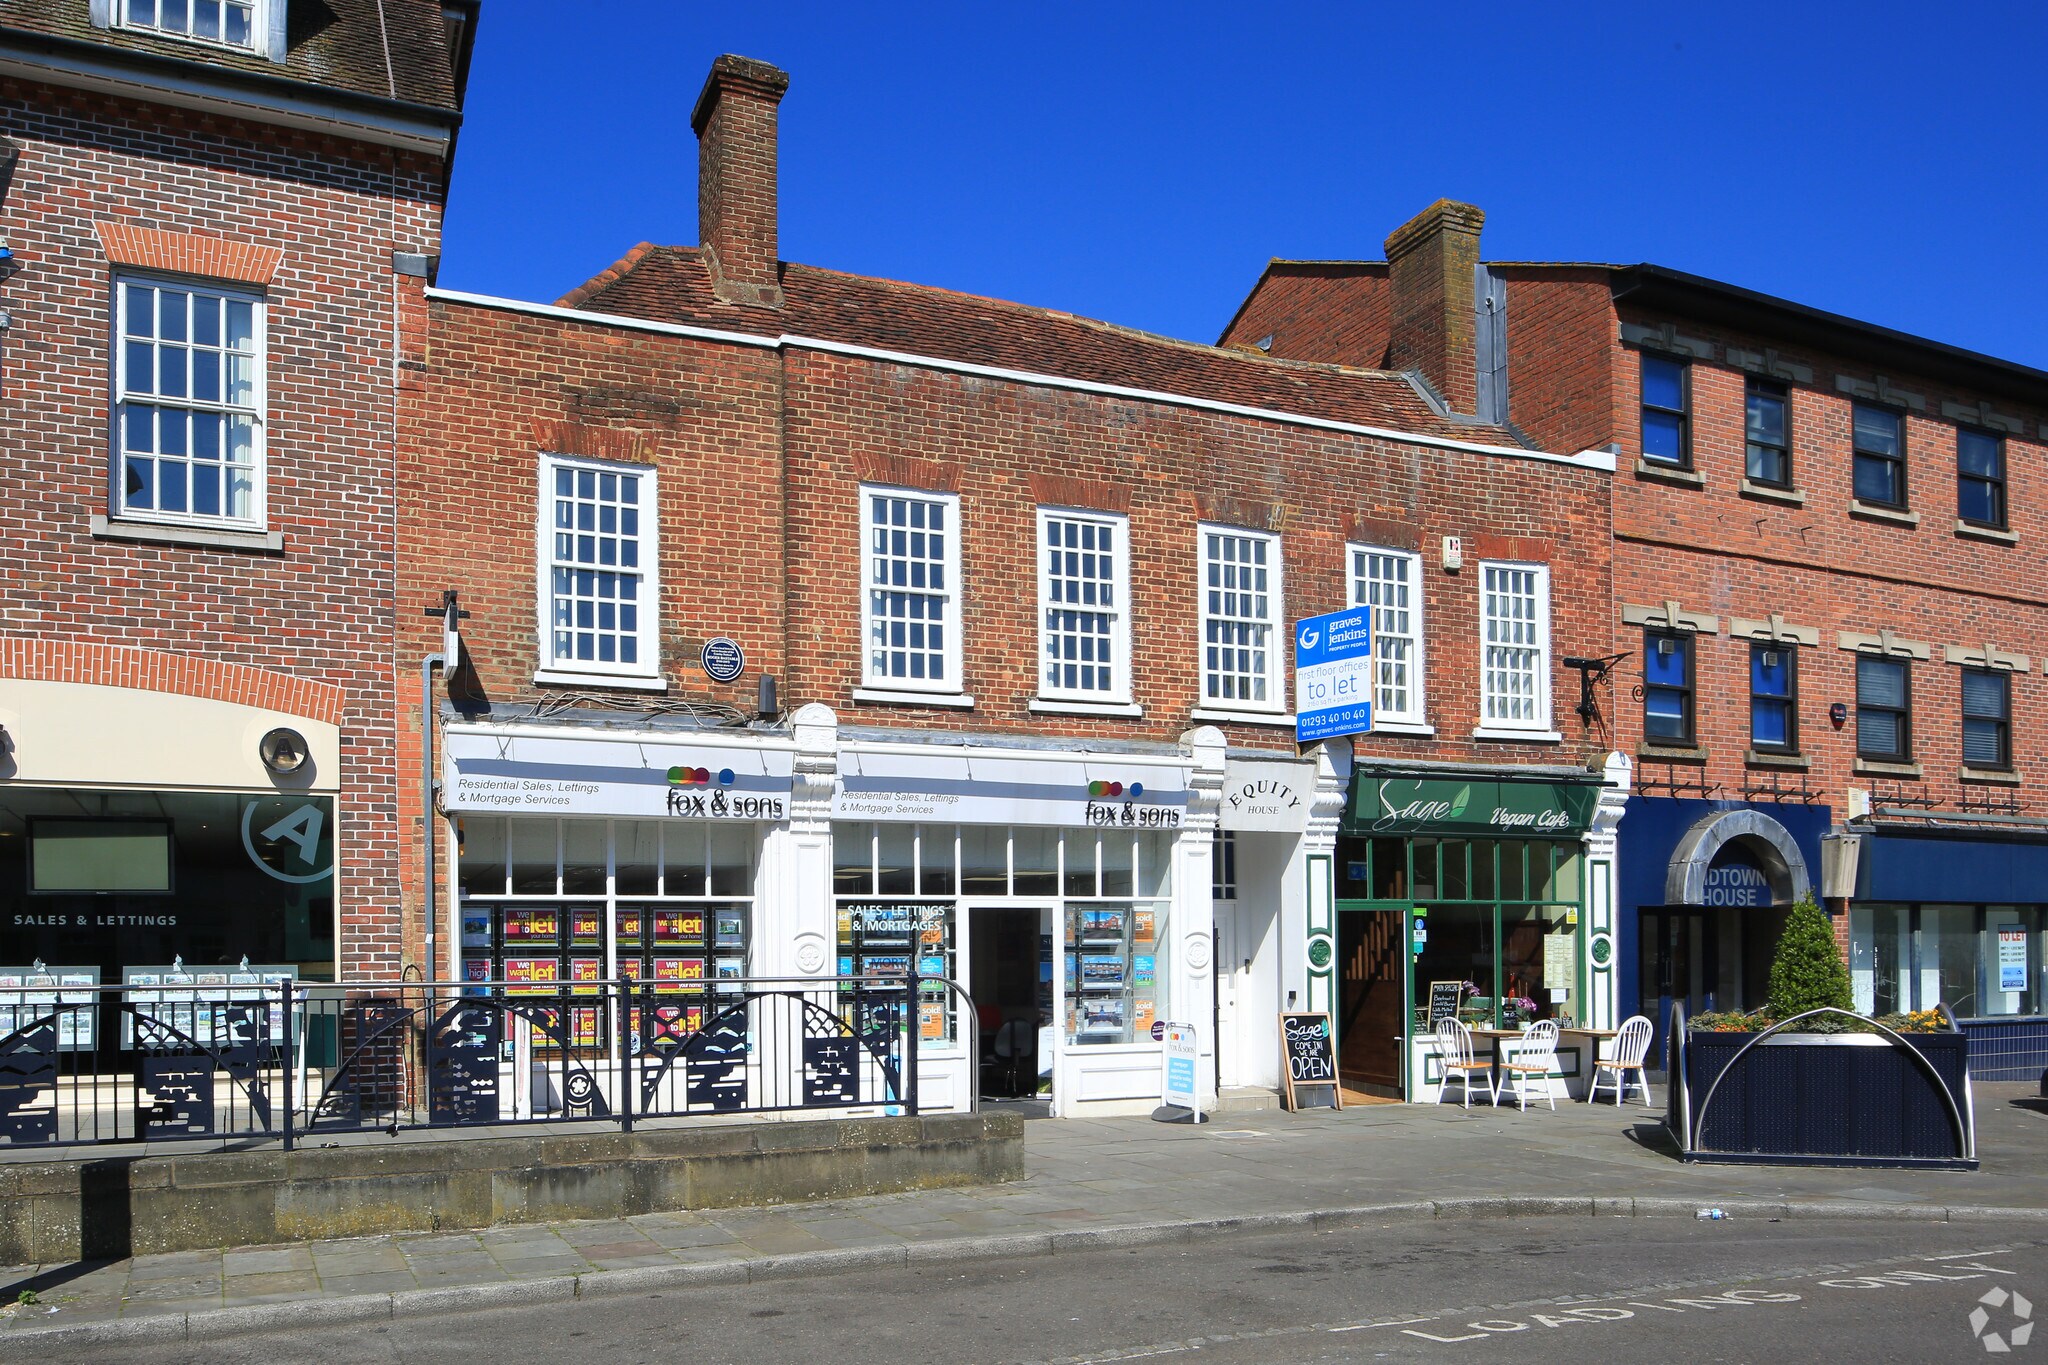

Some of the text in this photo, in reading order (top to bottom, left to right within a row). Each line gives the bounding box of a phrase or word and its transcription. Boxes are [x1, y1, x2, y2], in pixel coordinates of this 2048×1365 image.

[1329, 616, 1361, 632] graves
[1328, 629, 1366, 646] jenkins
[1329, 644, 1350, 652] PROPERTY
[1298, 660, 1368, 680] first floor offices
[1308, 674, 1357, 700] to let
[1302, 709, 1364, 727] 01293 40 10 40
[1302, 722, 1365, 737] www.gravesenkins.com
[458, 779, 599, 794] Residential Sales, Lettings
[1229, 780, 1301, 808] EQUITY
[458, 793, 570, 805] & Mortgage Services
[666, 788, 782, 813] fox & sons
[841, 791, 959, 804] Residential Sales, Lettings
[1372, 773, 1450, 832] Sage
[840, 803, 934, 814] & Mortgage Services
[1085, 800, 1179, 822] fox & sons
[1248, 806, 1279, 814] HOUSE
[1490, 808, 1536, 831] Vegan
[260, 803, 324, 866] A
[1705, 869, 1766, 886] DTOWN
[1703, 888, 1756, 906] HOUSE
[847, 905, 945, 916] SALES, LETTINGS
[14, 915, 177, 925] SALES & LETTINGS
[530, 912, 555, 933] let
[581, 919, 596, 932] let
[623, 919, 638, 932] let
[678, 913, 702, 933] let
[853, 921, 861, 931] &
[868, 920, 940, 931] MORTGAGES
[1999, 931, 2025, 941] TO LET
[468, 969, 488, 979] high
[530, 962, 555, 981] let
[581, 968, 596, 980] let
[678, 962, 701, 978] let
[922, 1006, 941, 1014] sold!
[630, 1018, 639, 1030] et
[1284, 1018, 1322, 1040] Sage
[1295, 1042, 1312, 1050] COME
[1291, 1055, 1331, 1079] OPEN
[1400, 1262, 2017, 1342] LOADING ONLY
